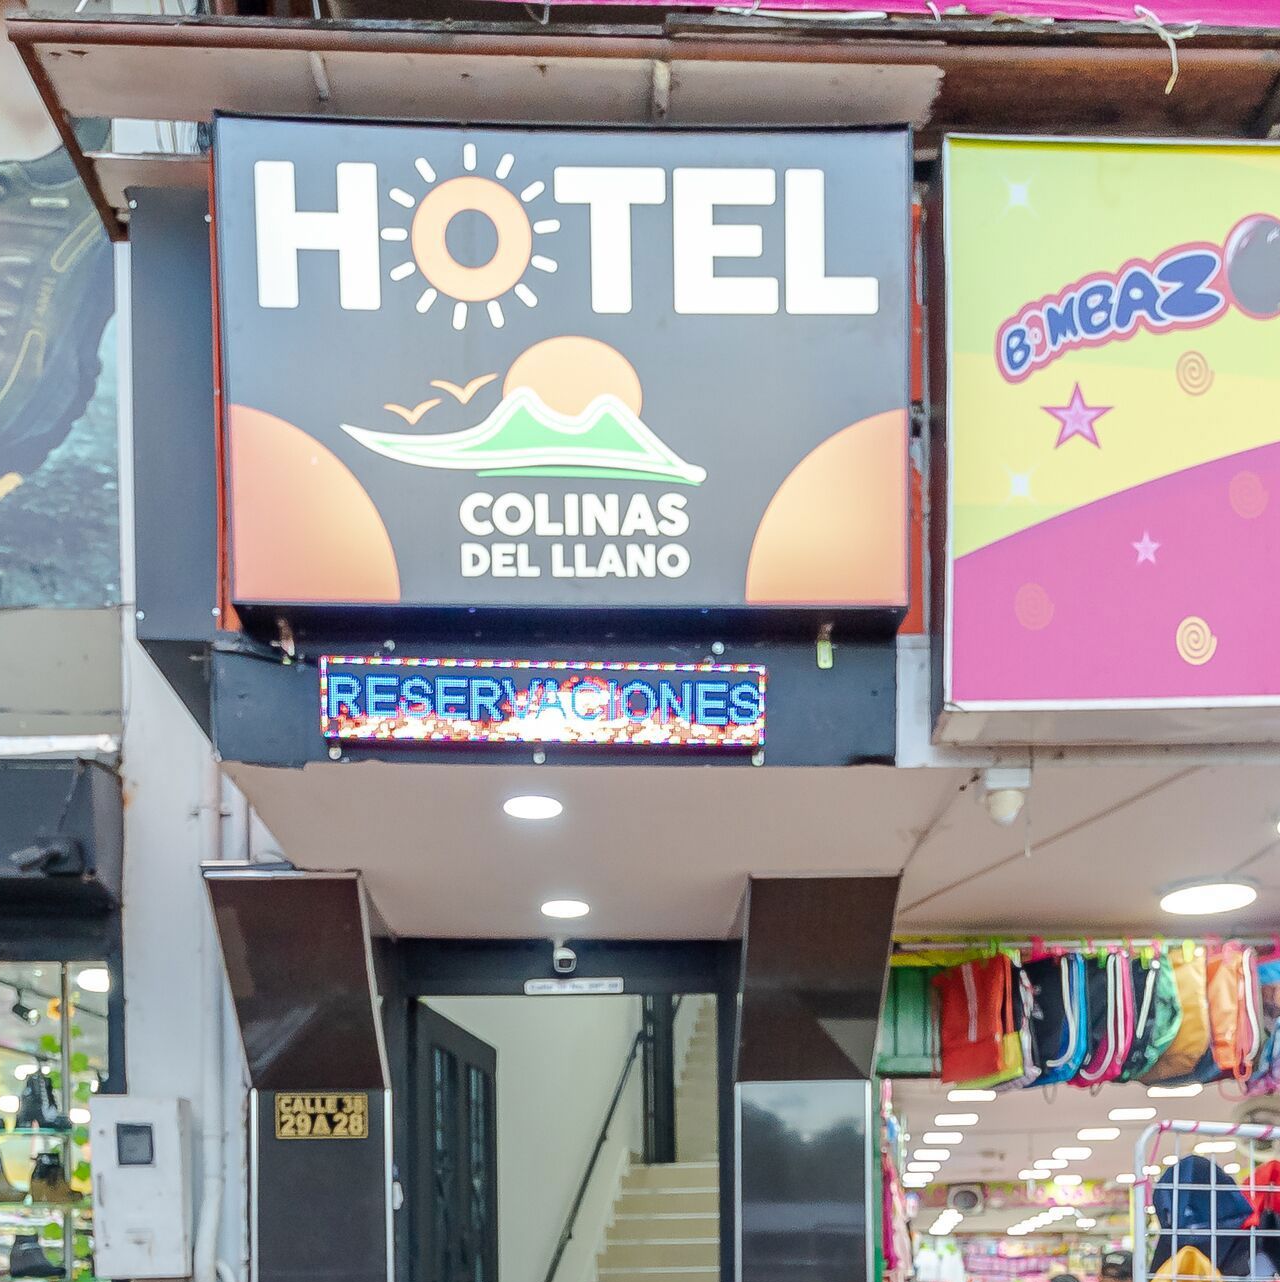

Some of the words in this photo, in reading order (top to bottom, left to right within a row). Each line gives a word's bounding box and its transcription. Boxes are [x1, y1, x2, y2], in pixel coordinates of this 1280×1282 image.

[253, 159, 880, 316] HOTEL
[459, 492, 690, 537] COLINAS
[460, 543, 541, 579] DEL
[550, 544, 691, 580] LLANO
[327, 672, 761, 727] RESERVACIONES
[280, 1095, 337, 1114] CALLE
